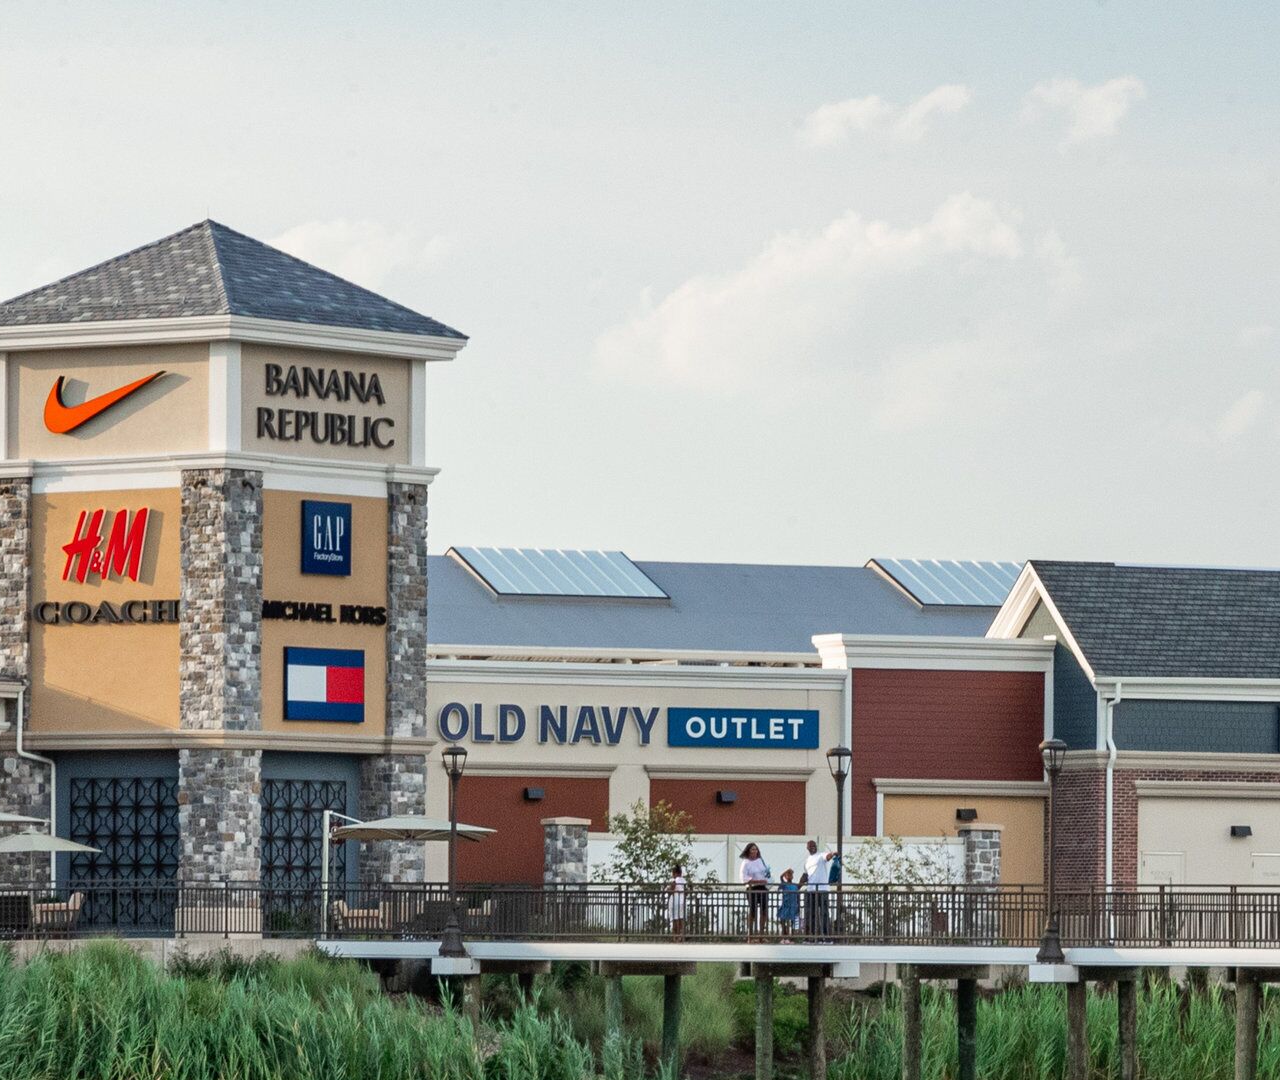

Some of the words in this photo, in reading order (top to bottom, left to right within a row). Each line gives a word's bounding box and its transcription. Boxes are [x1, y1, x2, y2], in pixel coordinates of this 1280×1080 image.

[265, 363, 386, 405] BANANA
[257, 407, 395, 449] REPUBLIC
[62, 508, 149, 584] H&M
[313, 514, 344, 551] GAP
[33, 600, 180, 624] COACH
[261, 600, 337, 623] MICHAEL
[340, 604, 387, 626] KORS
[438, 702, 527, 743] OLD
[538, 704, 660, 746] NAVY
[685, 717, 805, 740] OUTLET
